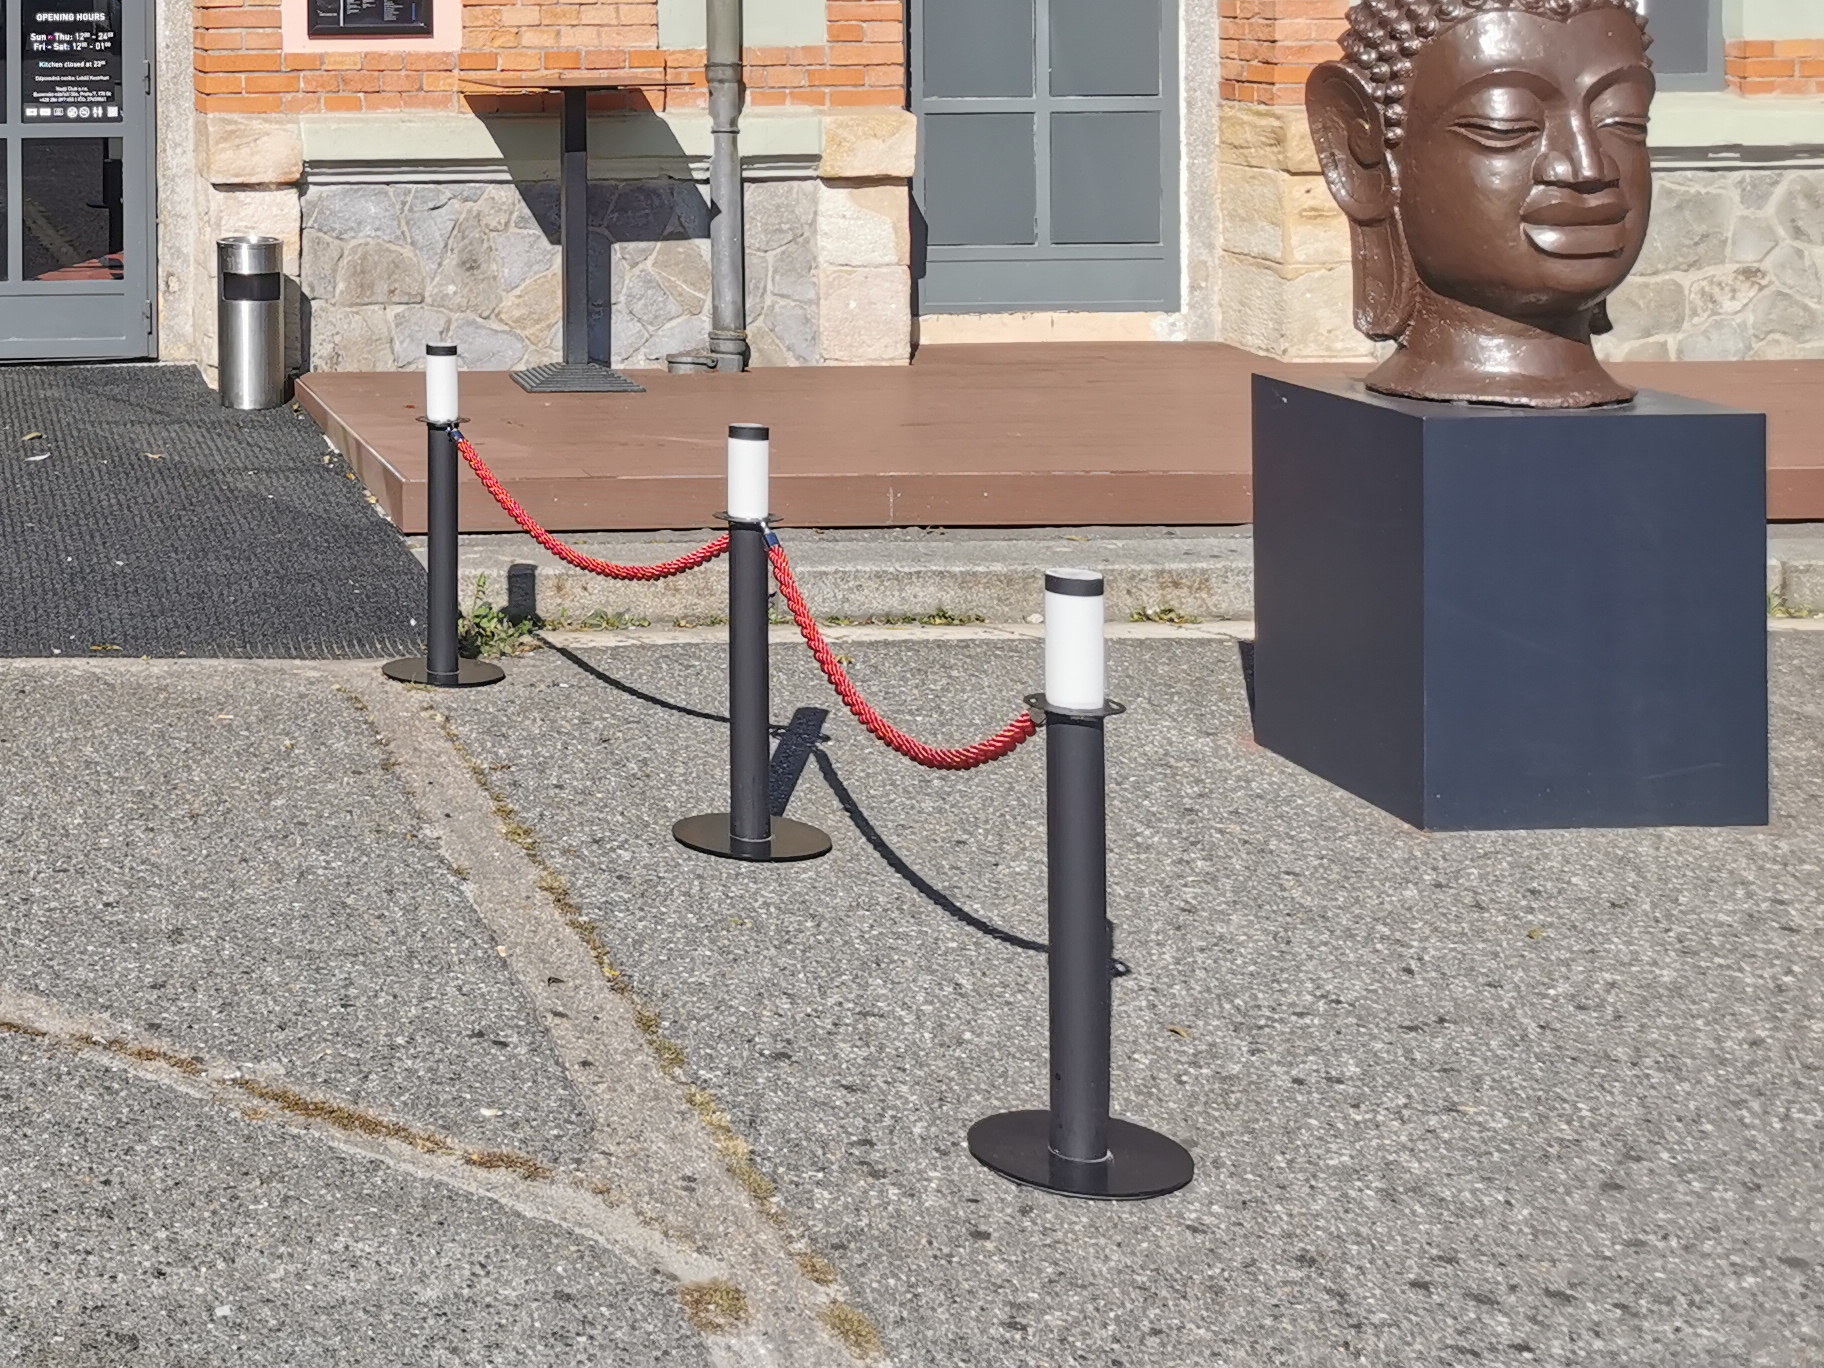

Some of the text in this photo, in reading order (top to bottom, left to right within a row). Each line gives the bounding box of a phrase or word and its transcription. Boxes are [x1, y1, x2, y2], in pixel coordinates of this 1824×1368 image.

[36, 13, 106, 21] OPENING HOURS
[30, 32, 47, 41] Sun
[54, 32, 73, 41] Thu:
[33, 42, 46, 51] Fri
[53, 42, 71, 51] Sat:
